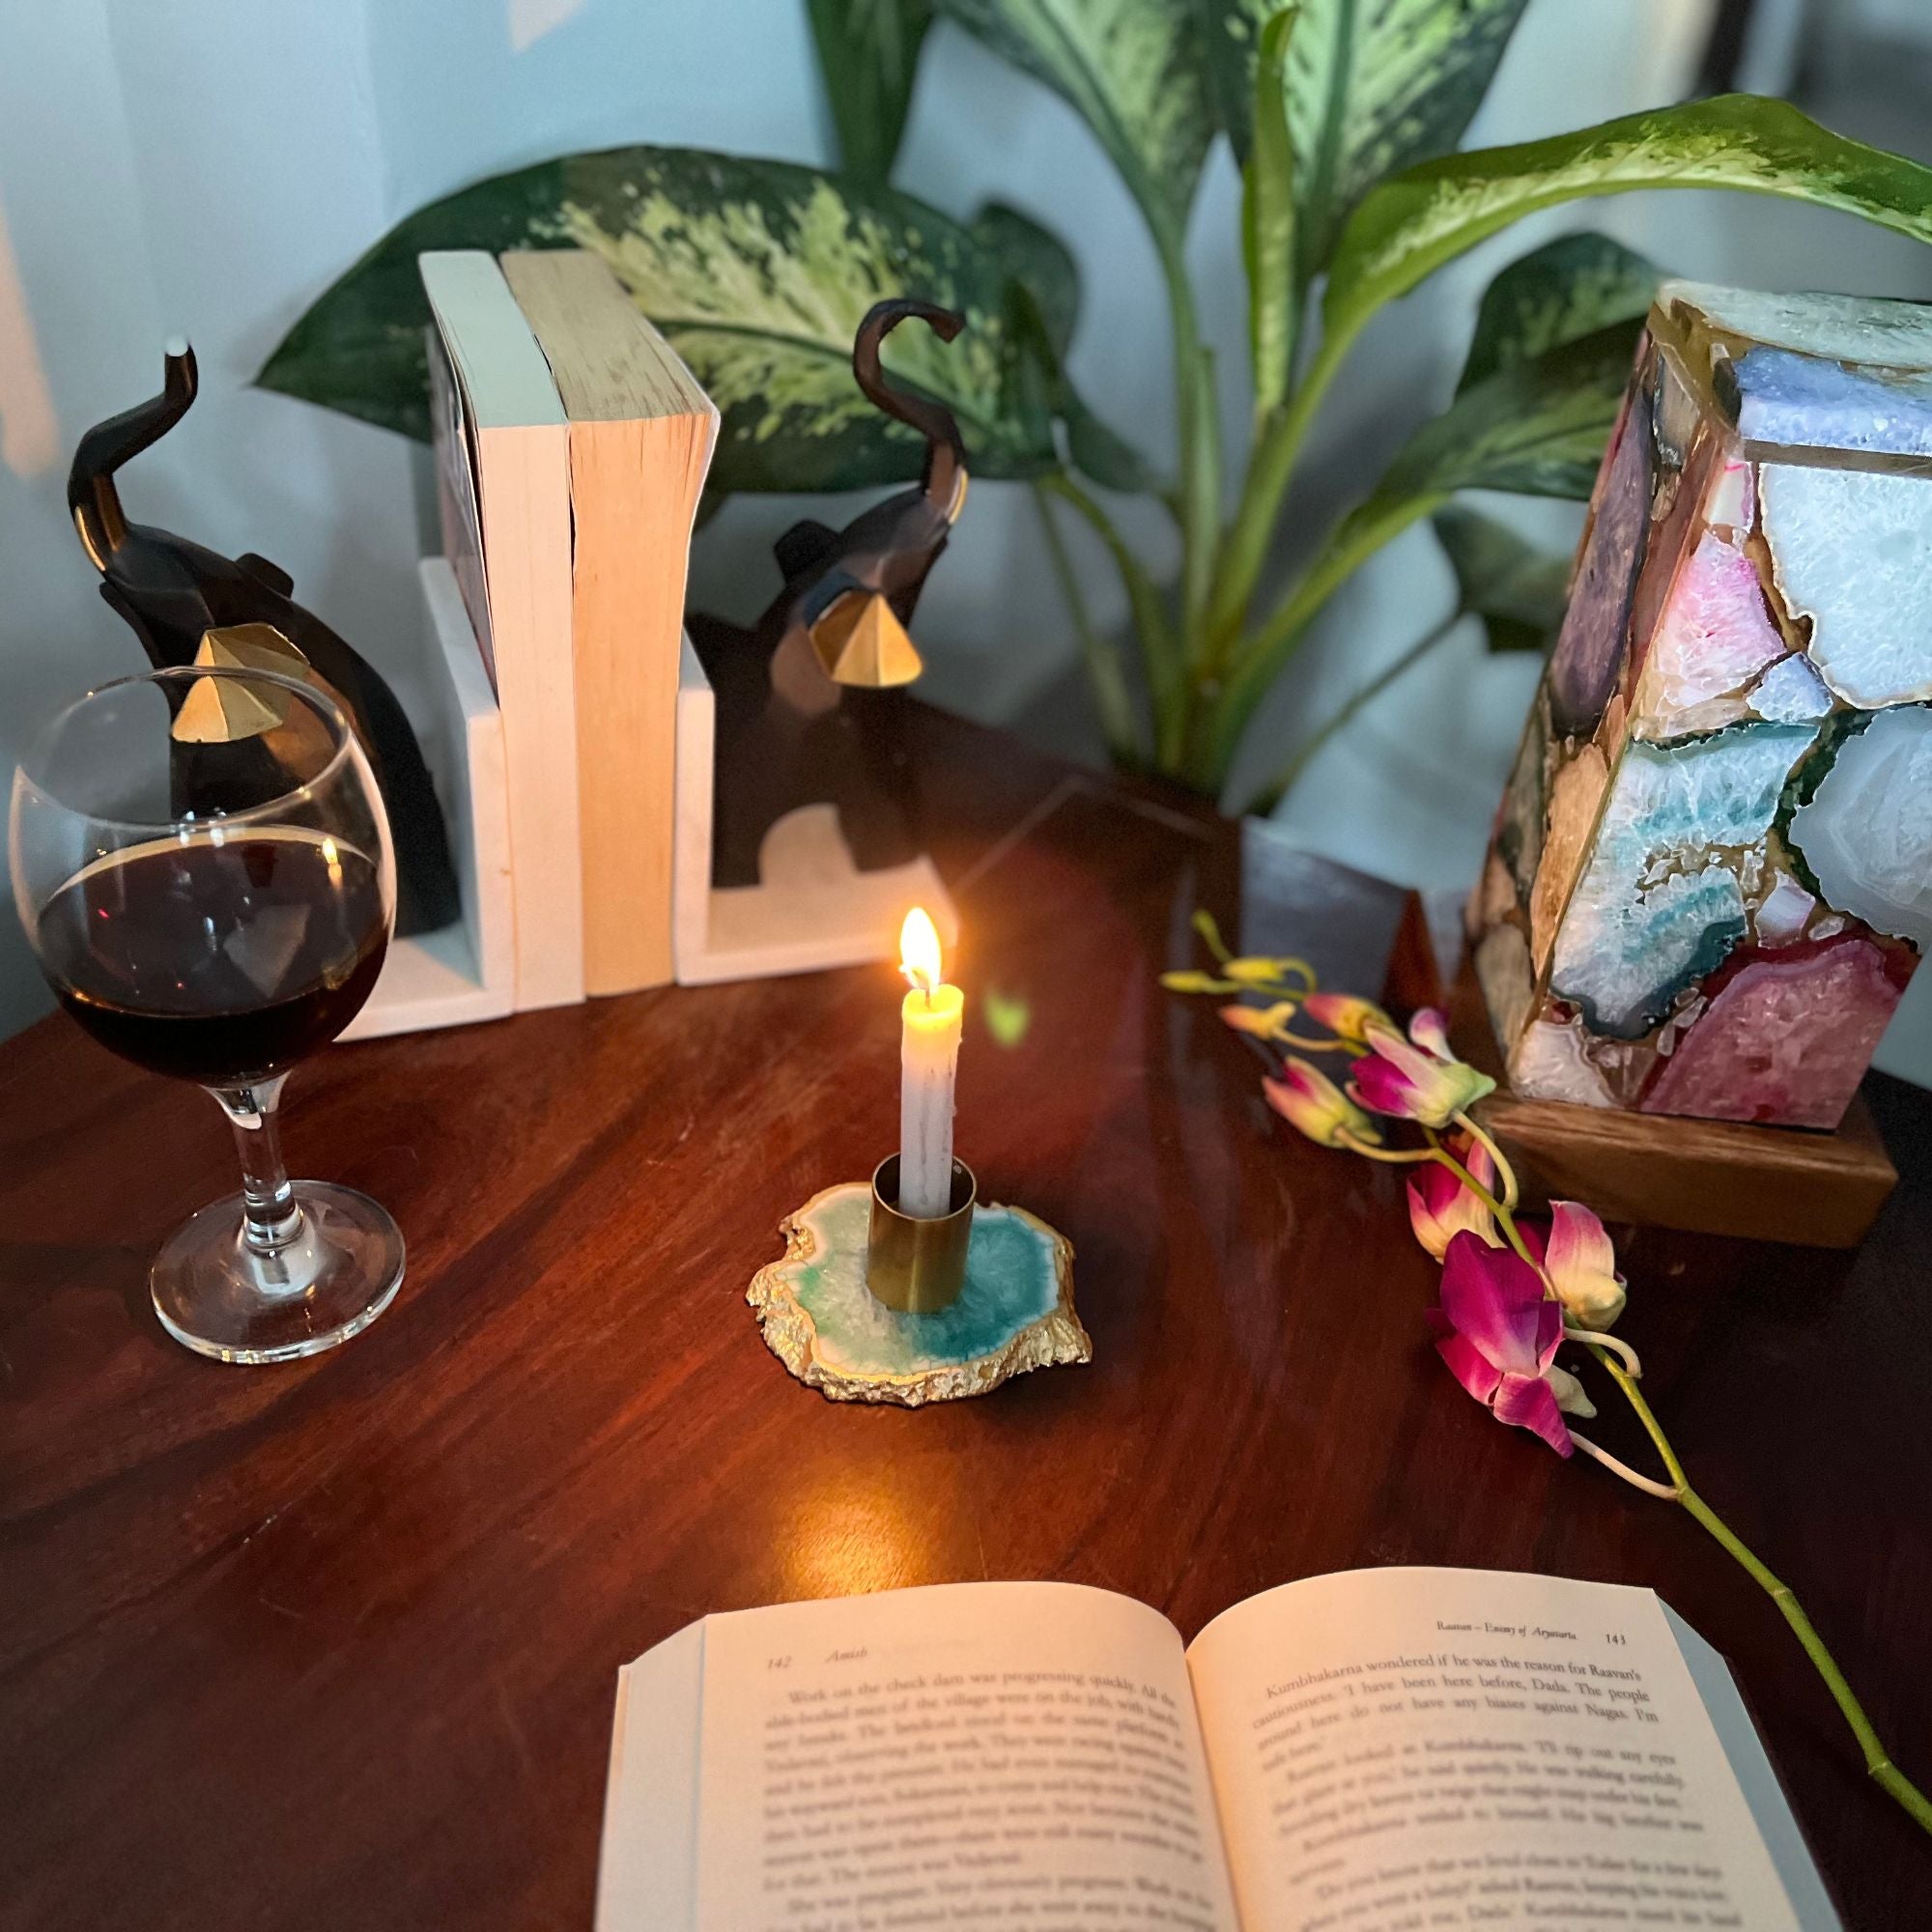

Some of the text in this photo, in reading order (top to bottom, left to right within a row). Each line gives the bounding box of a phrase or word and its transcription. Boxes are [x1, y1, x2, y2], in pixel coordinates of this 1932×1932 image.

[1485, 1622, 1516, 1636] Enemy
[1519, 1625, 1527, 1636] of
[1605, 1634, 1627, 1645] 143
[768, 1655, 792, 1669] 142
[825, 1646, 867, 1663] Amish
[1265, 1654, 1641, 1699] Kumbhakarna wondered if he was the reason for Raavan's
[789, 1690, 826, 1704] Work
[833, 1688, 852, 1698] on
[858, 1681, 880, 1695] the
[886, 1677, 926, 1692] check
[933, 1673, 964, 1687] dam
[970, 1673, 996, 1683] was
[1003, 1672, 1085, 1687] progressing
[1141, 1685, 1157, 1698] All
[1161, 1693, 1176, 1707] the
[1361, 1681, 1395, 1694] have
[1401, 1675, 1436, 1689] been
[1442, 1674, 1473, 1688] here
[1480, 1675, 1527, 1691] before,
[1531, 1678, 1570, 1693] Dada.
[1575, 1682, 1603, 1696] The
[1608, 1689, 1650, 1704] people
[893, 1698, 909, 1713] of
[917, 1696, 938, 1709] the
[947, 1693, 988, 1708] village
[997, 1693, 1030, 1703] were
[1036, 1692, 1055, 1702] on
[1060, 1690, 1081, 1704] the
[1117, 1699, 1144, 1714] with
[1258, 1695, 1660, 1751] around here do not have any biases against Nagas. I'm
[1620, 1750, 1642, 1764] any
[1649, 1753, 1676, 1765] eyes
